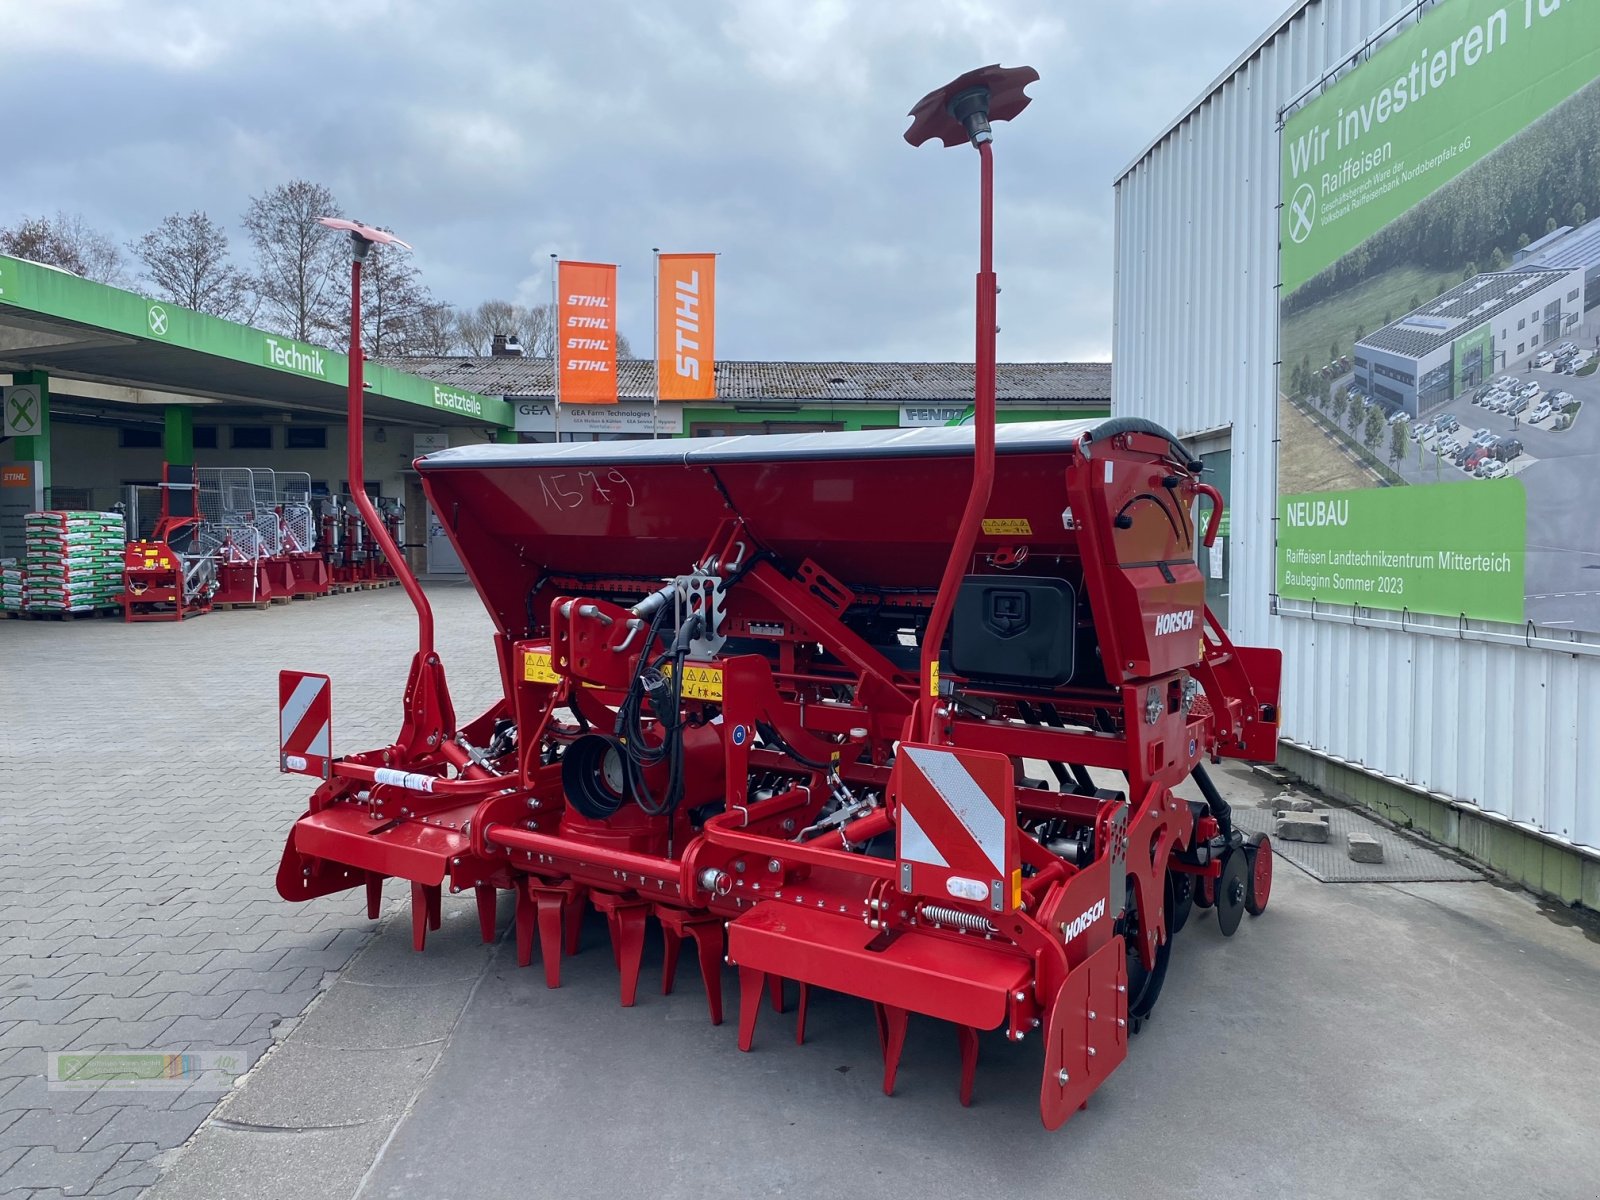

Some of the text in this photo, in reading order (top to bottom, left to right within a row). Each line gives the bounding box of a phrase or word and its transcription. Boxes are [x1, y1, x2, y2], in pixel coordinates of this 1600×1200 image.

[1290, 7, 1507, 179] Wir investieren
[1321, 141, 1392, 197] Raiffeisen
[1321, 136, 1471, 226] Volksbank Raiffeisenbank Nordoberpfalz eG
[1321, 161, 1405, 214] Geschäftsbereich Ware der
[567, 295, 609, 308] STIHL
[567, 317, 609, 330] STIHL
[675, 270, 699, 381] STIHL
[567, 338, 609, 351] STIHL
[266, 339, 325, 376] Technik
[567, 360, 609, 372] STIHL
[434, 386, 482, 415] Ersatzteile
[519, 405, 551, 416] GEA
[607, 410, 651, 418] Technologies
[906, 409, 965, 420] FENDT
[4, 473, 27, 481] STIHL
[1286, 500, 1349, 527] NEUBAU
[1286, 549, 1511, 572] Raiffeisen Landtechnikzentrum Mitterteich
[1285, 571, 1404, 594] Baubeginn Sommer 2023
[1155, 610, 1194, 636] HORSCH
[1065, 897, 1106, 945] HORSCH
